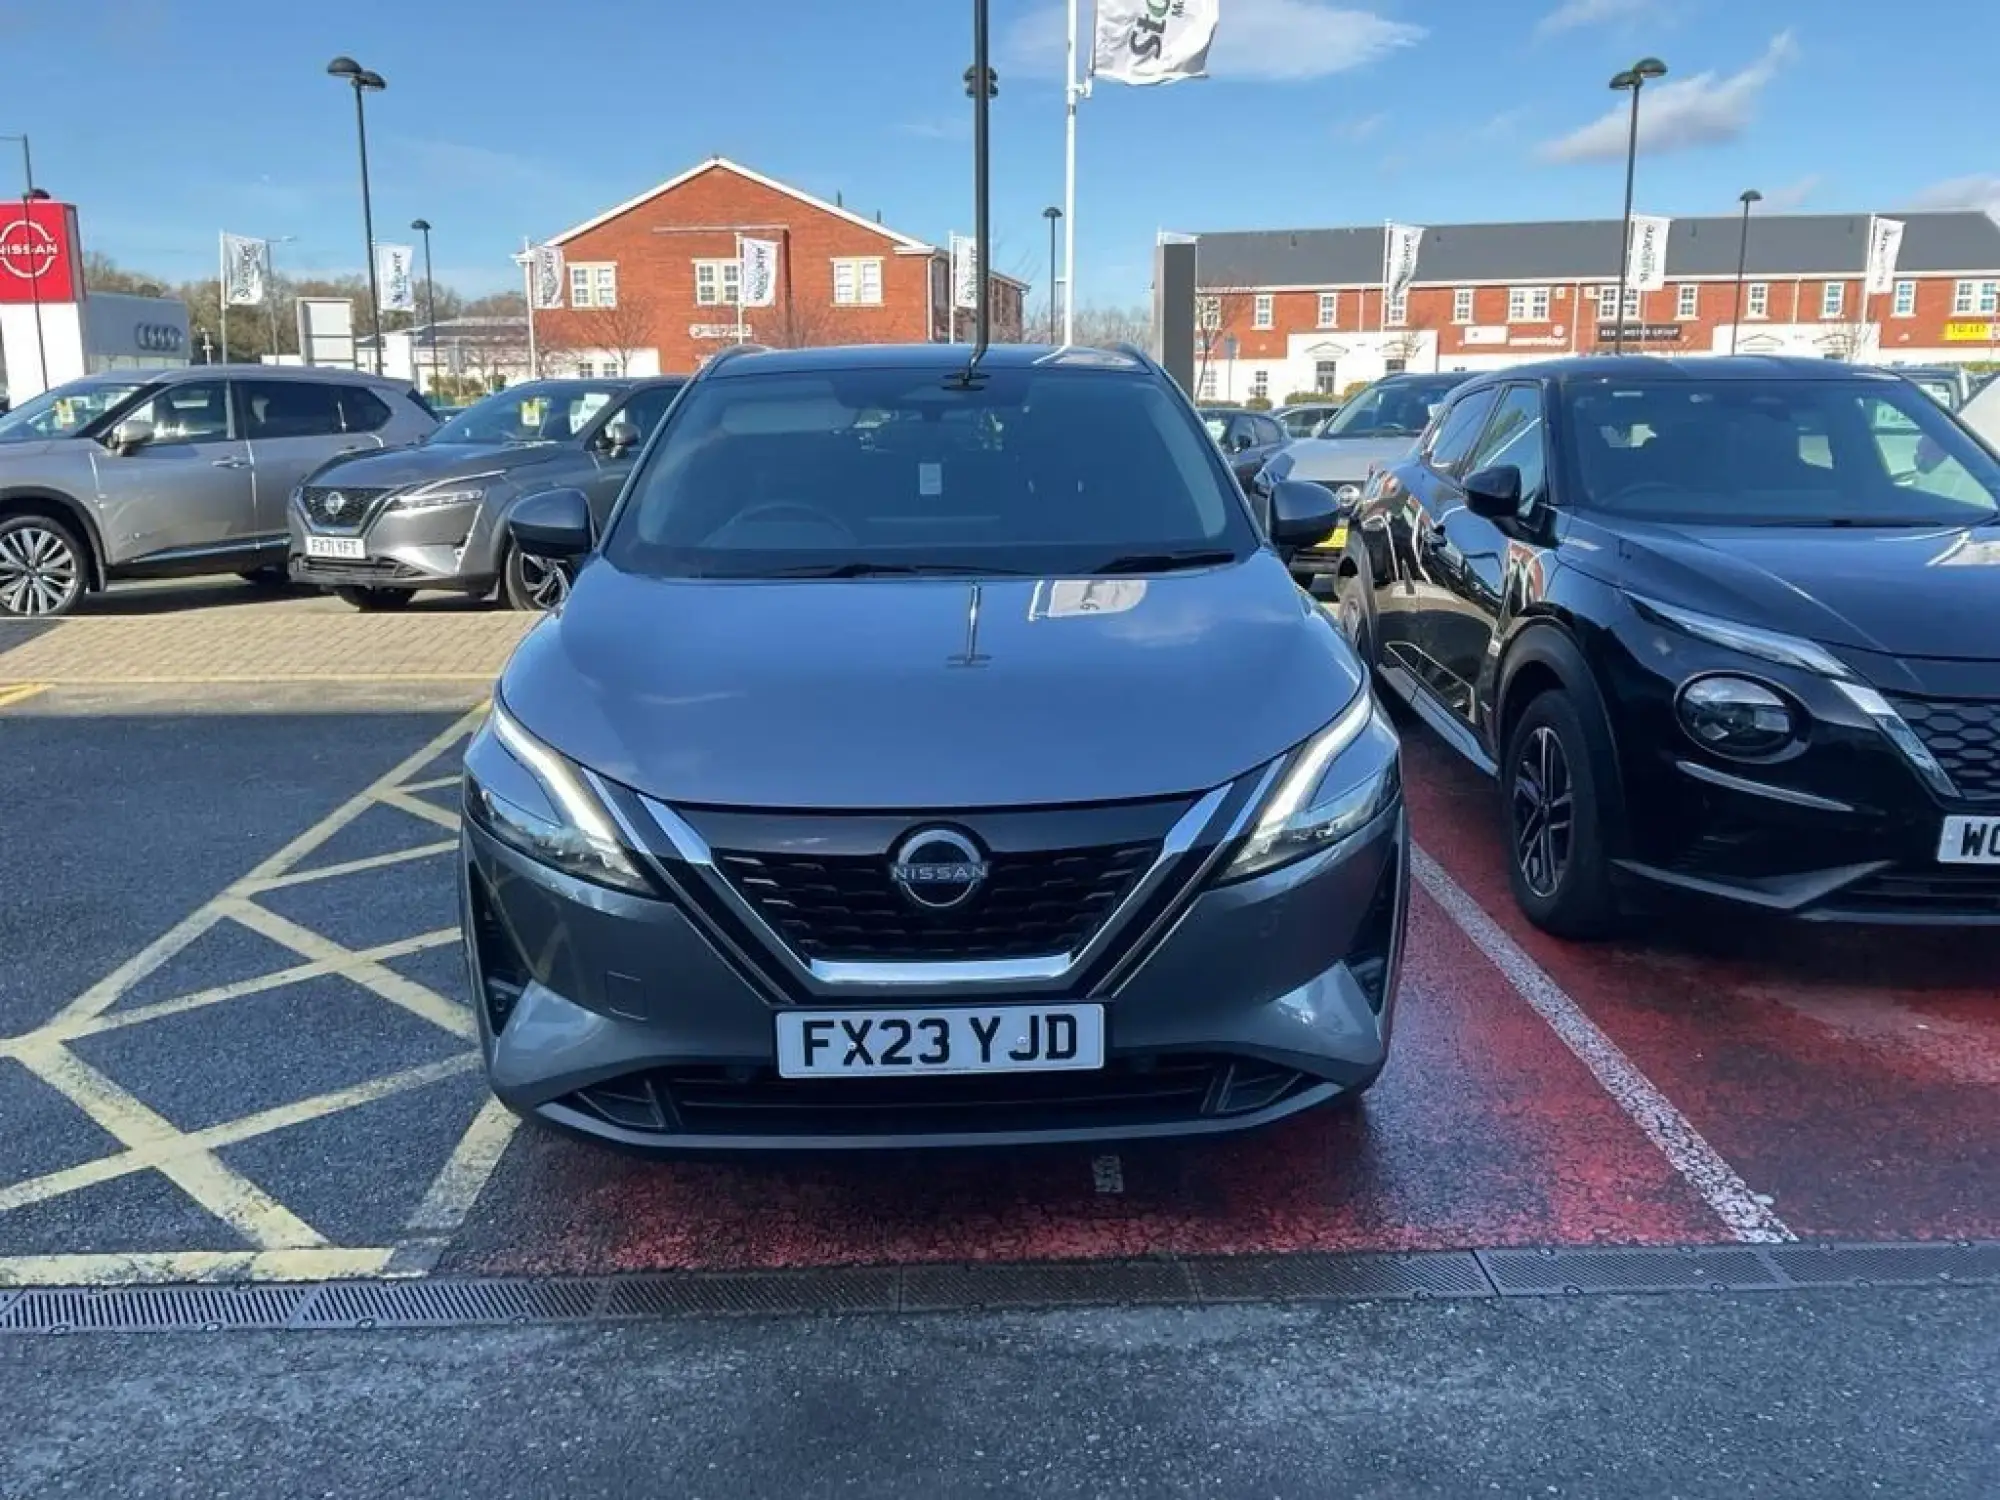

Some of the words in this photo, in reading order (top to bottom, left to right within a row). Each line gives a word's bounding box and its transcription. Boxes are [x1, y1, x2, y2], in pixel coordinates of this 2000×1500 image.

[893, 864, 986, 881] NISSAN
[803, 1019, 950, 1067] FX23
[969, 1013, 1078, 1063] YJD
